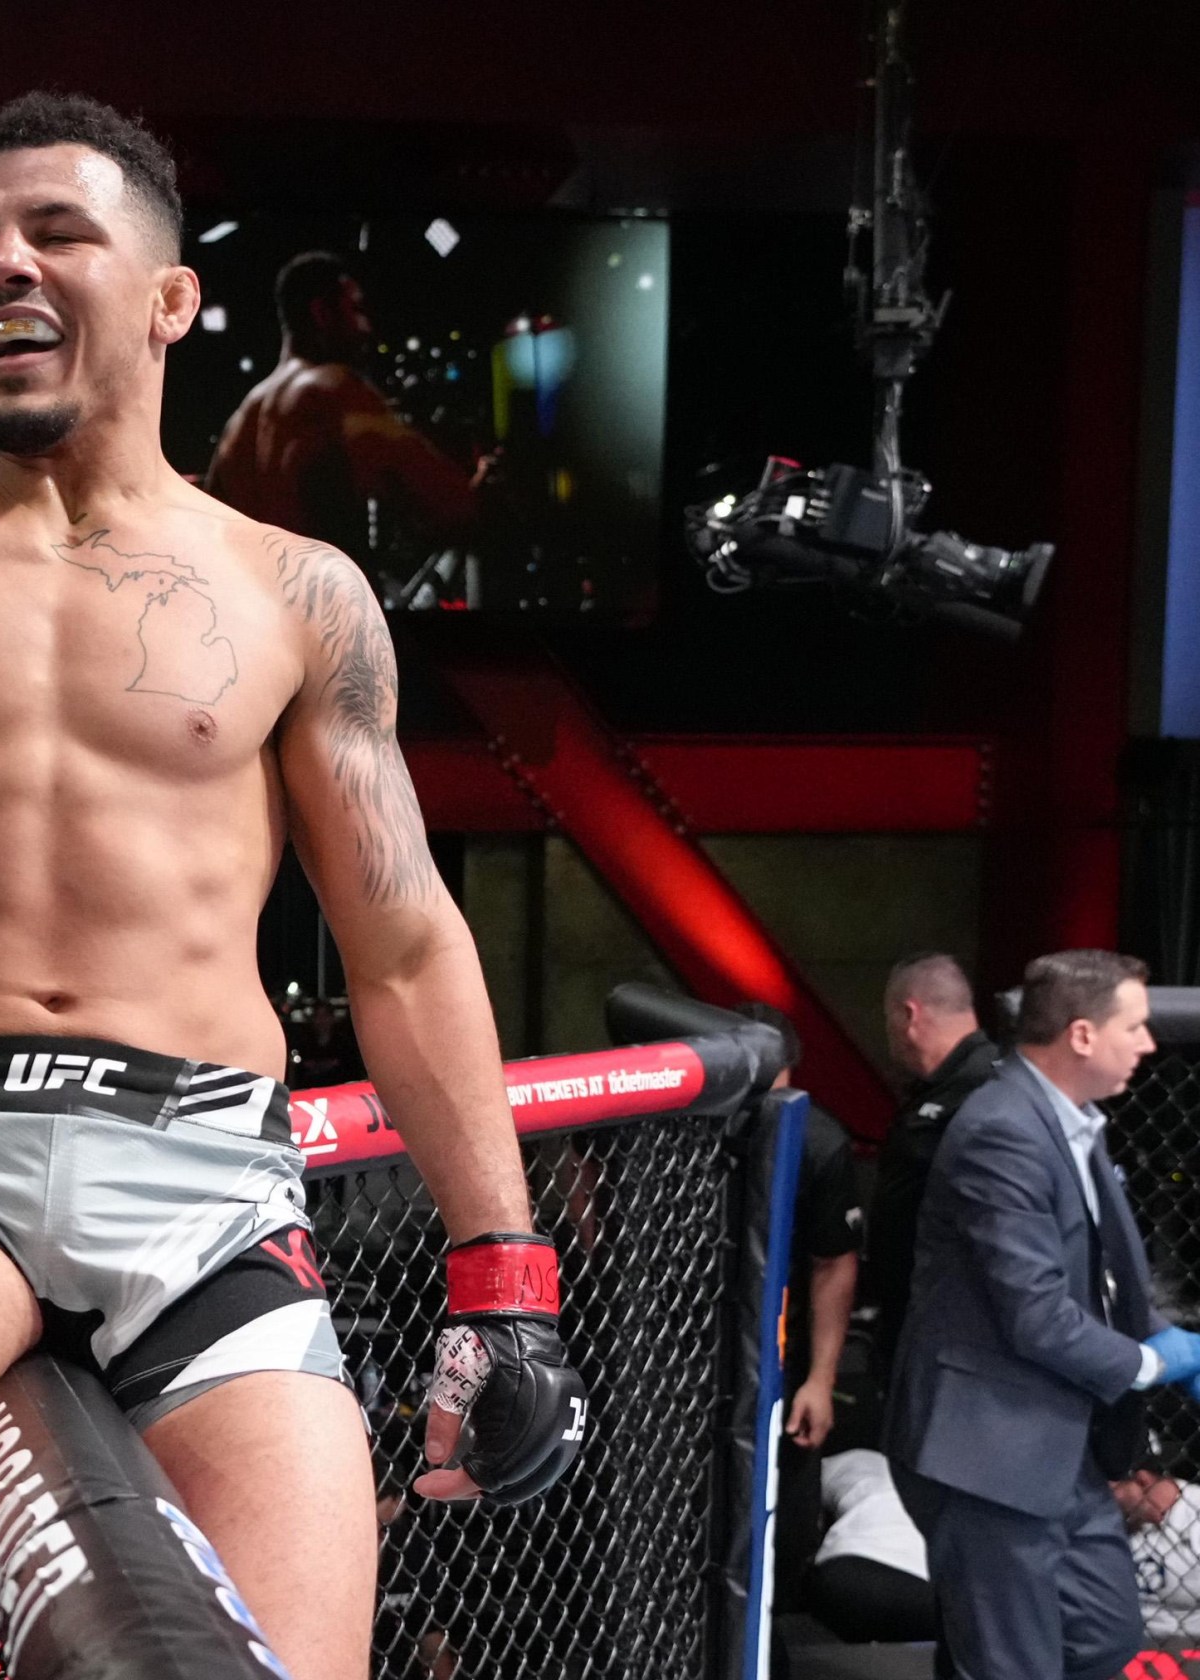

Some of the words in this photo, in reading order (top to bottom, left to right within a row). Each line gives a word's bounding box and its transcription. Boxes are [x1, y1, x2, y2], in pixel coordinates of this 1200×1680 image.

[3, 1053, 128, 1096] UFC
[506, 1084, 533, 1107] BUY
[532, 1077, 589, 1103] TICKETS
[588, 1075, 604, 1097] AT
[608, 1067, 684, 1095] ticketmaster
[448, 1329, 472, 1359] UFC
[445, 1366, 476, 1391] UFC
